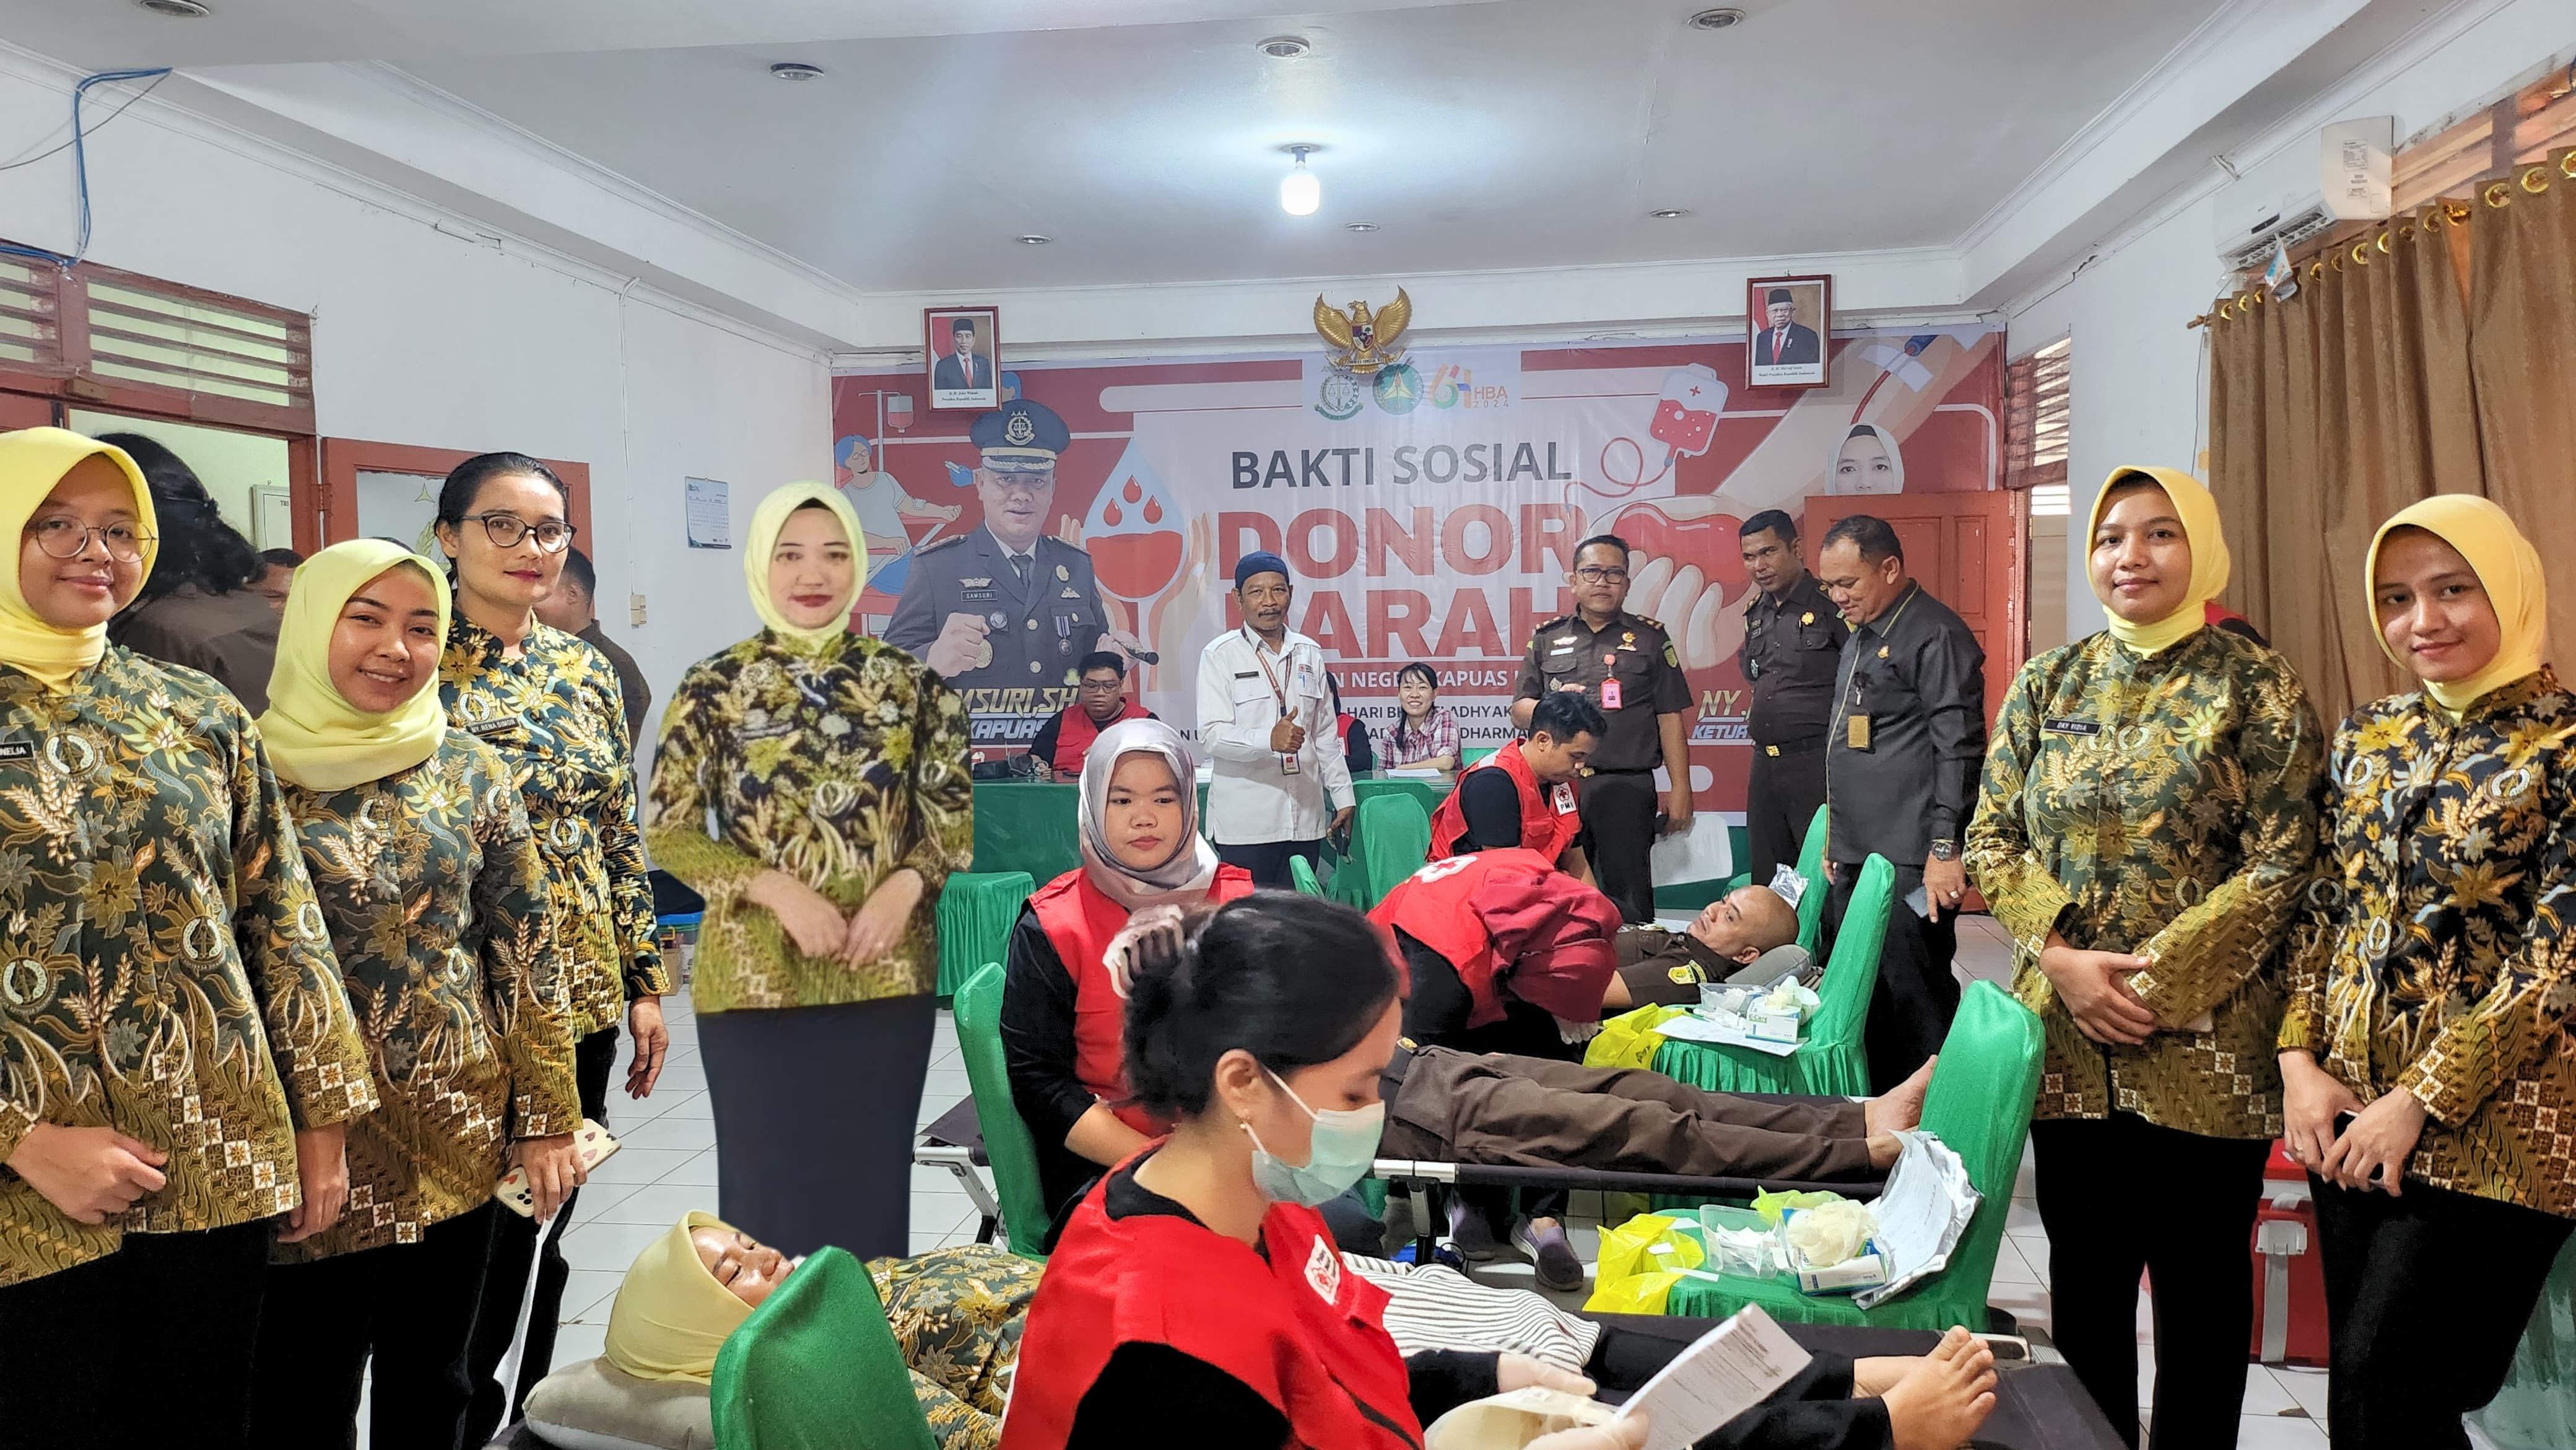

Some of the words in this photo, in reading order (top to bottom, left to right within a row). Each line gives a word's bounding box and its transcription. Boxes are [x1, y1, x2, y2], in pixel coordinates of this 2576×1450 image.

[1474, 386, 1508, 400] HBA
[1474, 400, 1509, 409] 2024
[1232, 447, 1374, 489] BAKTI
[1393, 442, 1572, 485] SOSIAL
[1218, 504, 1588, 580] DONOR
[1347, 706, 1383, 718] HARI
[1451, 705, 1512, 718] ADHYAK
[1460, 727, 1528, 740] DHARMA
[1691, 724, 1749, 740] KETUA
[1560, 801, 1574, 811] PMI
